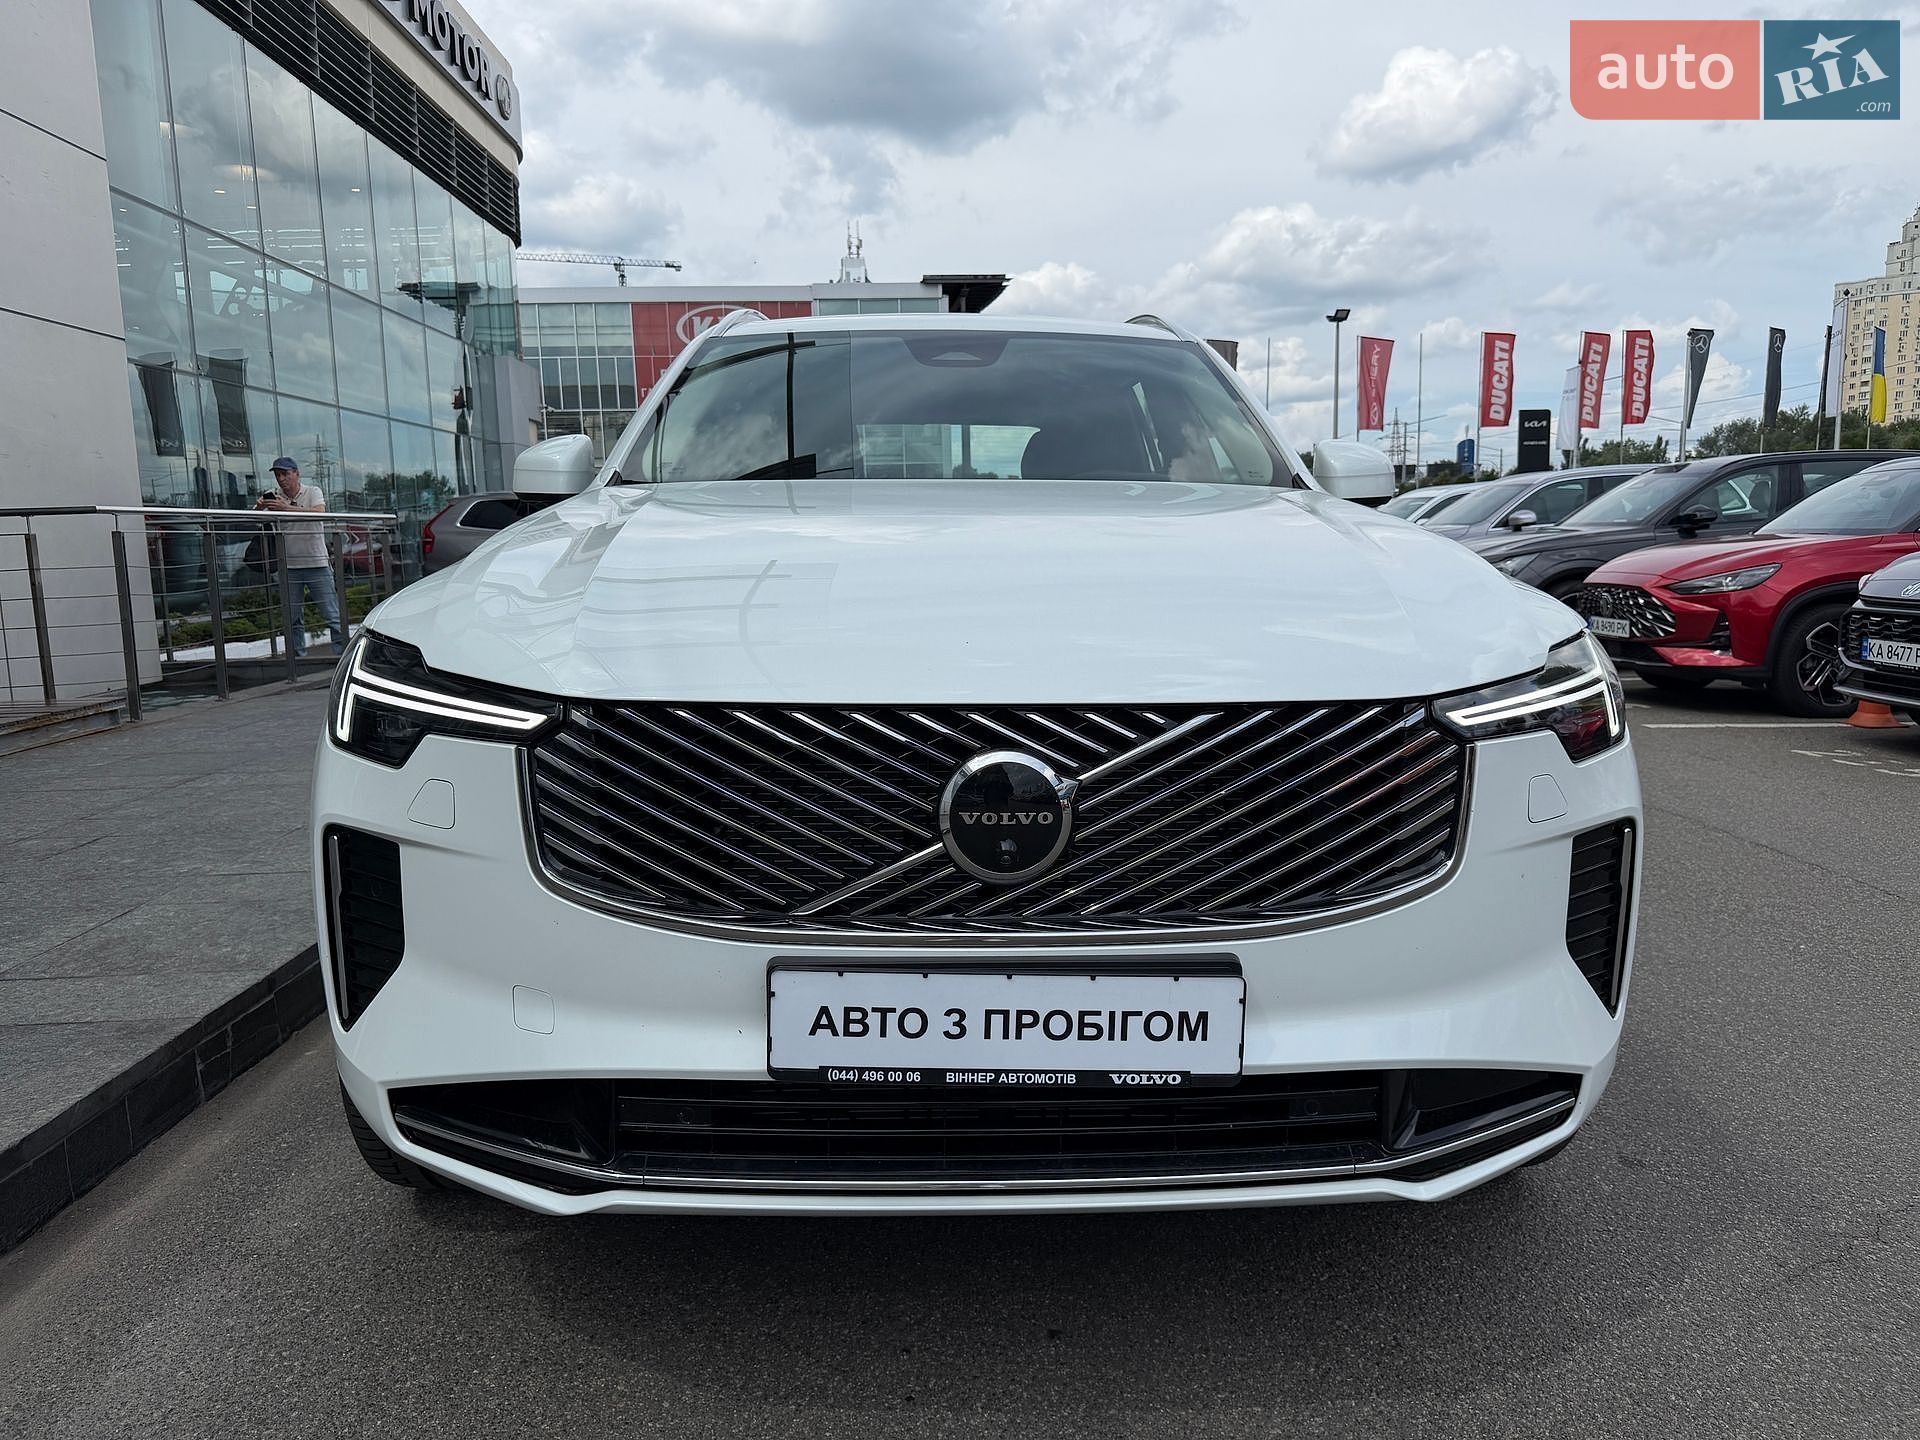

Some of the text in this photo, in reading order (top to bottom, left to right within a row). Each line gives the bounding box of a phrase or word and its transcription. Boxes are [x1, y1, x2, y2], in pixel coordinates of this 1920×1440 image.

[408, 0, 493, 101] MOTOR
[1489, 340, 1510, 421] DUCATI
[1582, 342, 1604, 422] DUCATI
[1631, 337, 1650, 418] DUCATI
[1868, 642, 1884, 659] KA
[1887, 644, 1913, 662] 8477
[959, 812, 1054, 825] VOLVO
[808, 1005, 929, 1040] АВТО
[983, 1009, 1210, 1042] ПРОБІГОМ
[827, 1068, 921, 1082] (044) 496 00 06
[946, 1072, 1077, 1085] ВІННЕР АВТОМОТІВ
[1109, 1073, 1182, 1085] VOLVO
